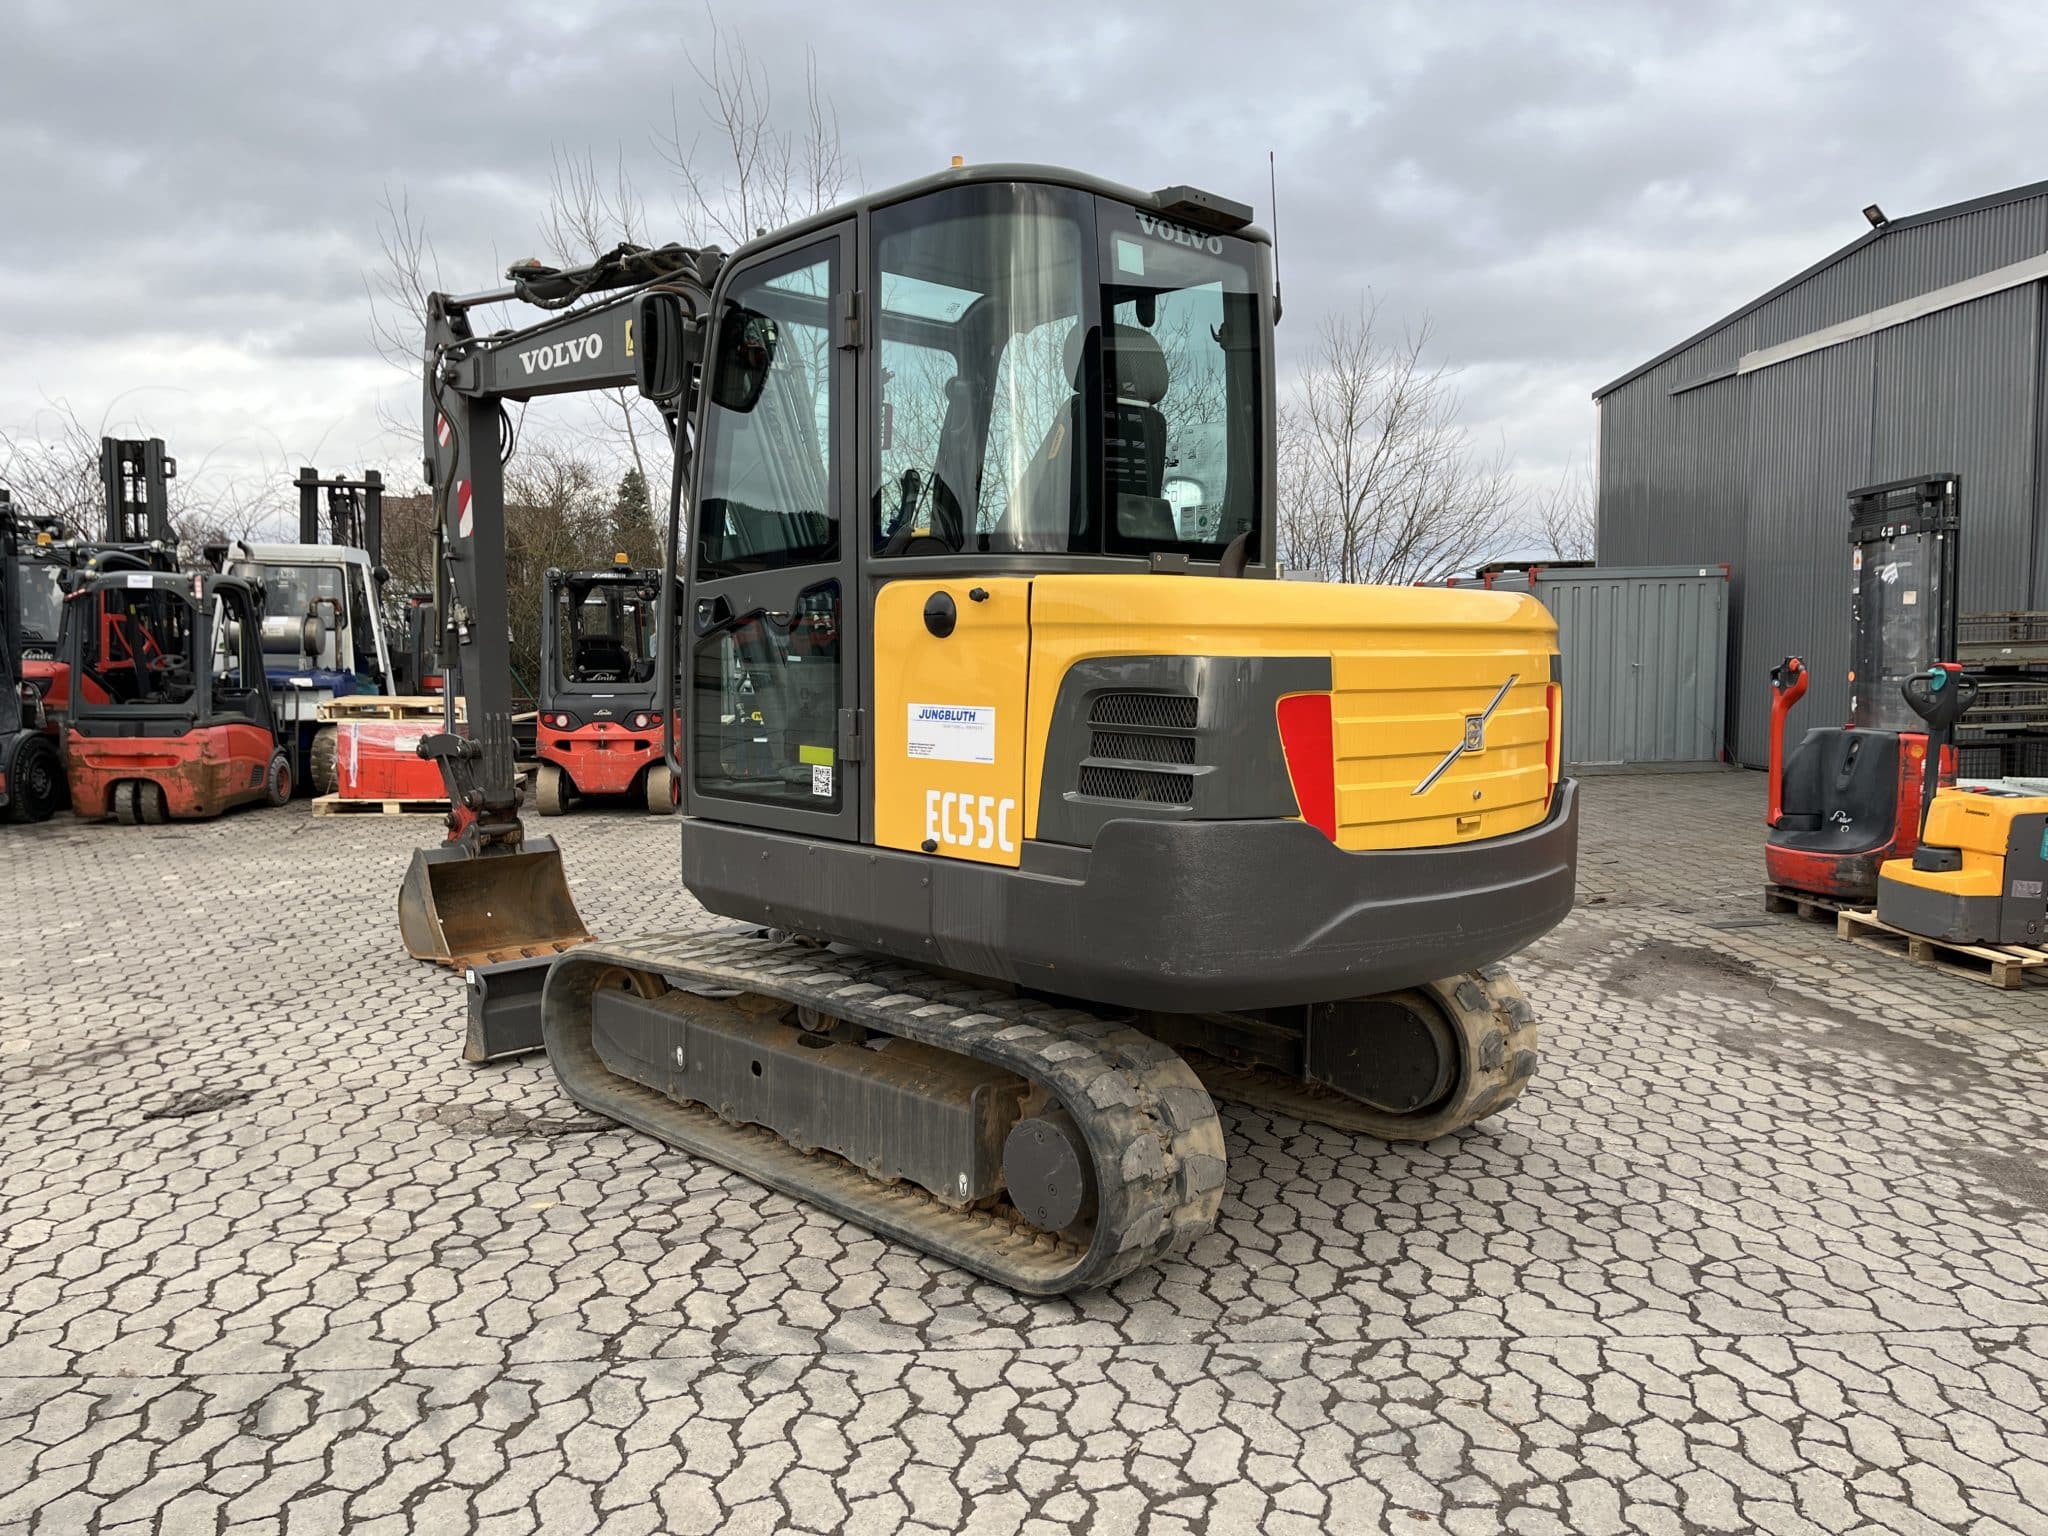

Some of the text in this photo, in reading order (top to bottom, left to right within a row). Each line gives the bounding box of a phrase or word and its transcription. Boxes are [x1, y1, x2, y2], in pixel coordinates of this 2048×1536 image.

[1136, 212, 1223, 255] VOLVO
[519, 333, 603, 375] VOLVO
[918, 709, 976, 722] JUNGBLUTH
[926, 789, 1015, 853] EC55C
